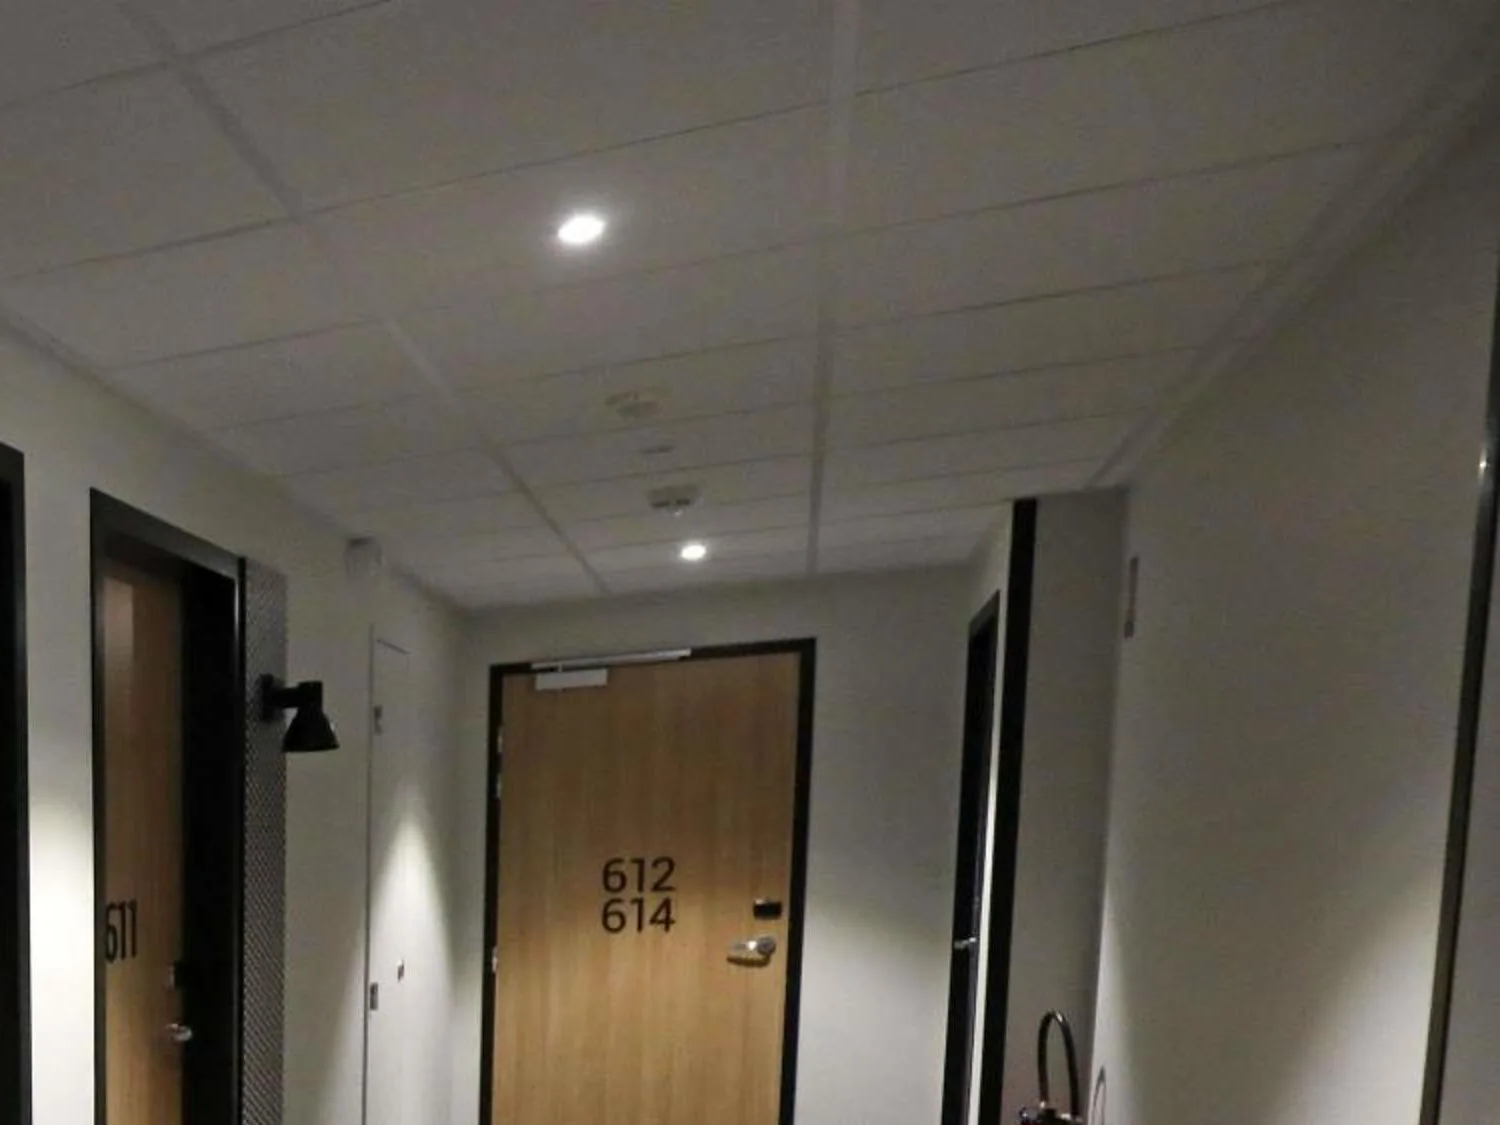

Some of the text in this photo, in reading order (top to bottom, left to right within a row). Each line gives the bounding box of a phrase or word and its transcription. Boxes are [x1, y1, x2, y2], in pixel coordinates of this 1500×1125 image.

[602, 857, 675, 893] 612
[105, 900, 137, 962] 611
[601, 897, 675, 933] 614
